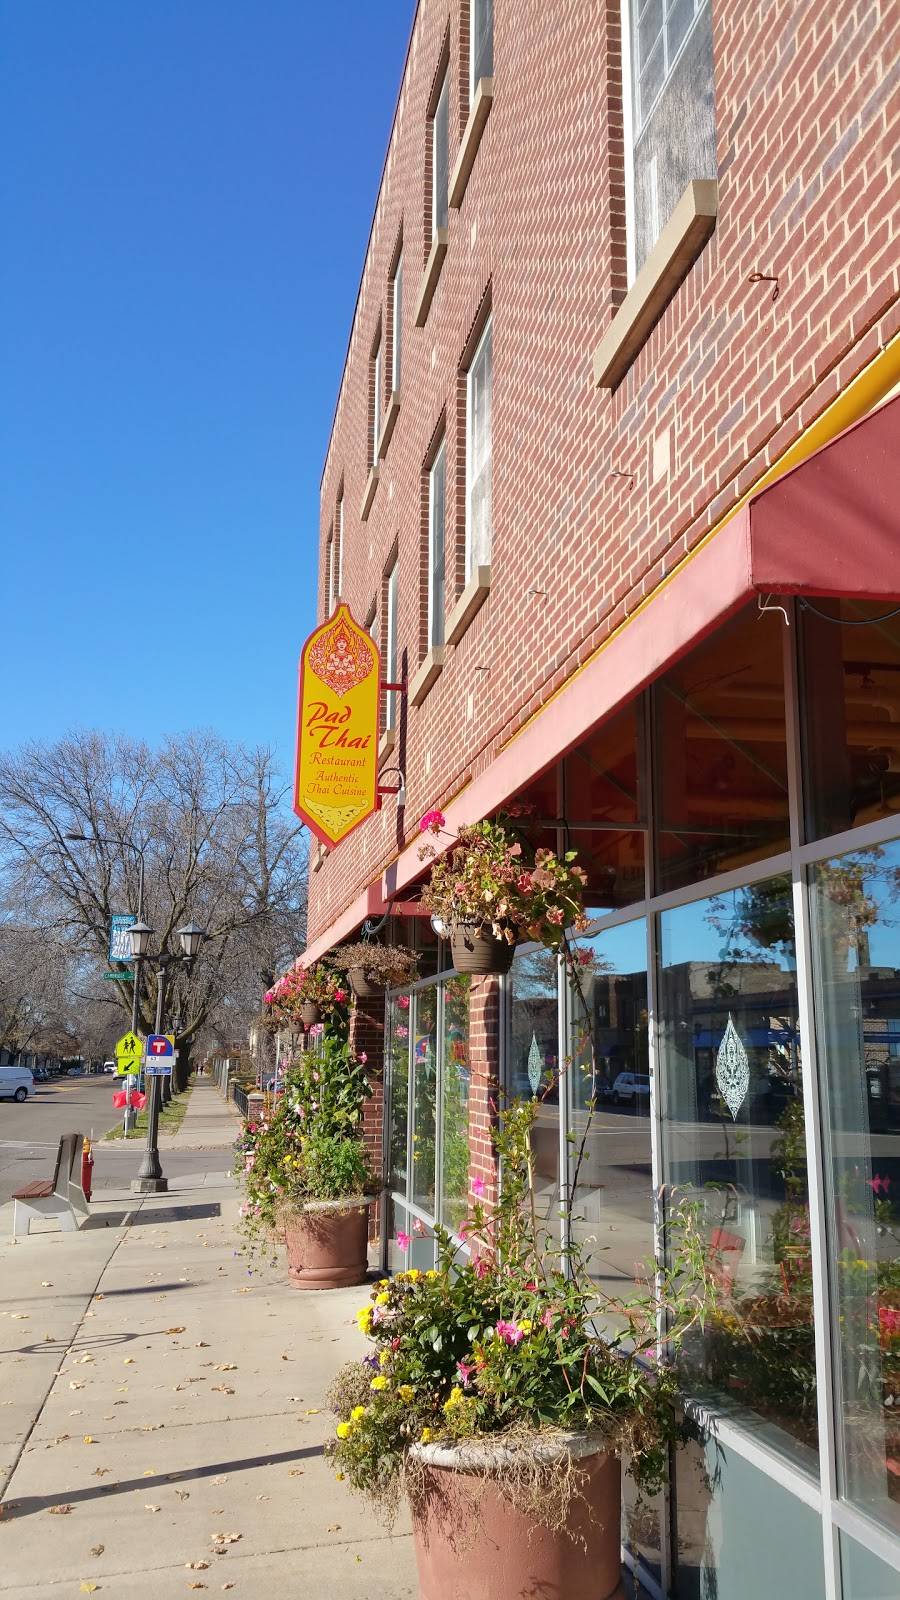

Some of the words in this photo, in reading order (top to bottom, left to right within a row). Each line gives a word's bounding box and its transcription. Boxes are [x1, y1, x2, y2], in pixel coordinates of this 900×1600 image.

[306, 701, 352, 727] Pad
[309, 725, 371, 748] Thai
[309, 751, 366, 767] Restaurant
[315, 770, 360, 783] Authentic
[306, 782, 330, 794] Thai
[333, 783, 367, 796] Cuisine
[152, 1041, 166, 1054] T
